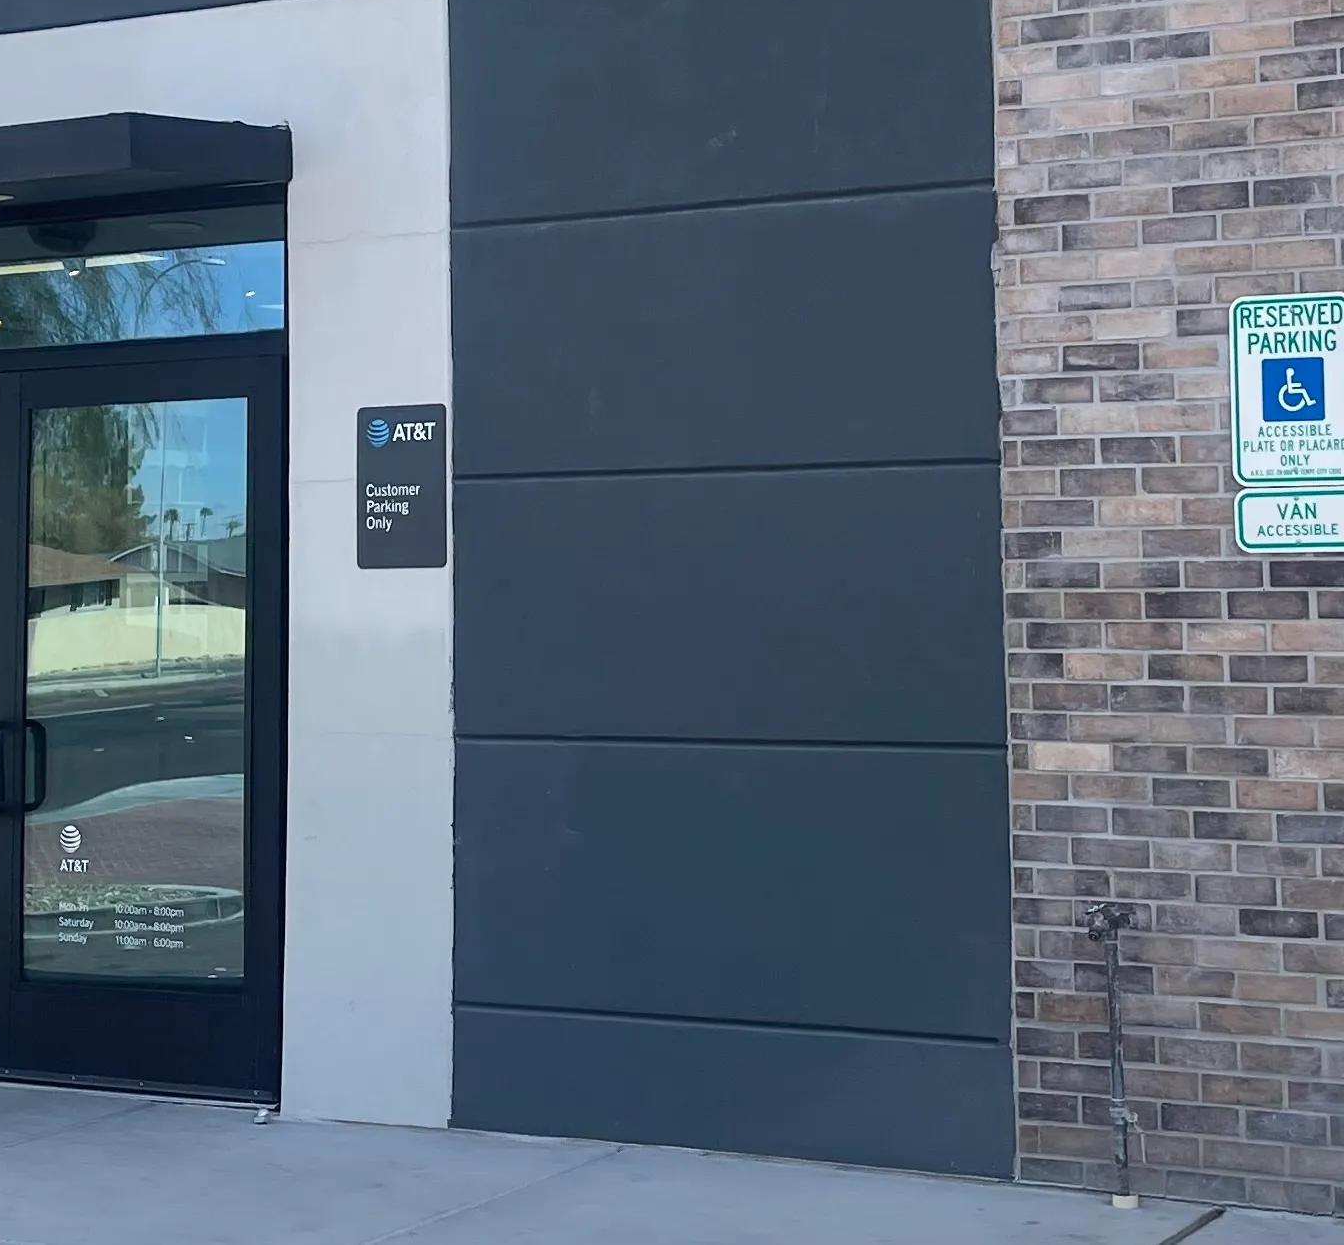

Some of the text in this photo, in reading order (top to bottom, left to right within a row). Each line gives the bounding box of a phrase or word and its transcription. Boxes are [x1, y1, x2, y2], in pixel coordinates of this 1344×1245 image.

[1240, 302, 1343, 329] RESERVED
[1247, 329, 1337, 355] PARKING
[392, 421, 436, 442] AT&T
[1257, 424, 1332, 438] ACCESSIBLE
[1243, 440, 1276, 453] PLATE
[1280, 439, 1294, 452] OR
[1280, 454, 1311, 467] ONLY
[365, 483, 421, 497] Customer
[365, 499, 410, 515] Parking
[1277, 502, 1317, 520] VAN
[365, 515, 393, 532] Only
[1256, 523, 1340, 538] ACCESSIBLE
[59, 859, 90, 873] AT&T
[58, 916, 94, 930] Saturday
[58, 932, 87, 945] Sunday
